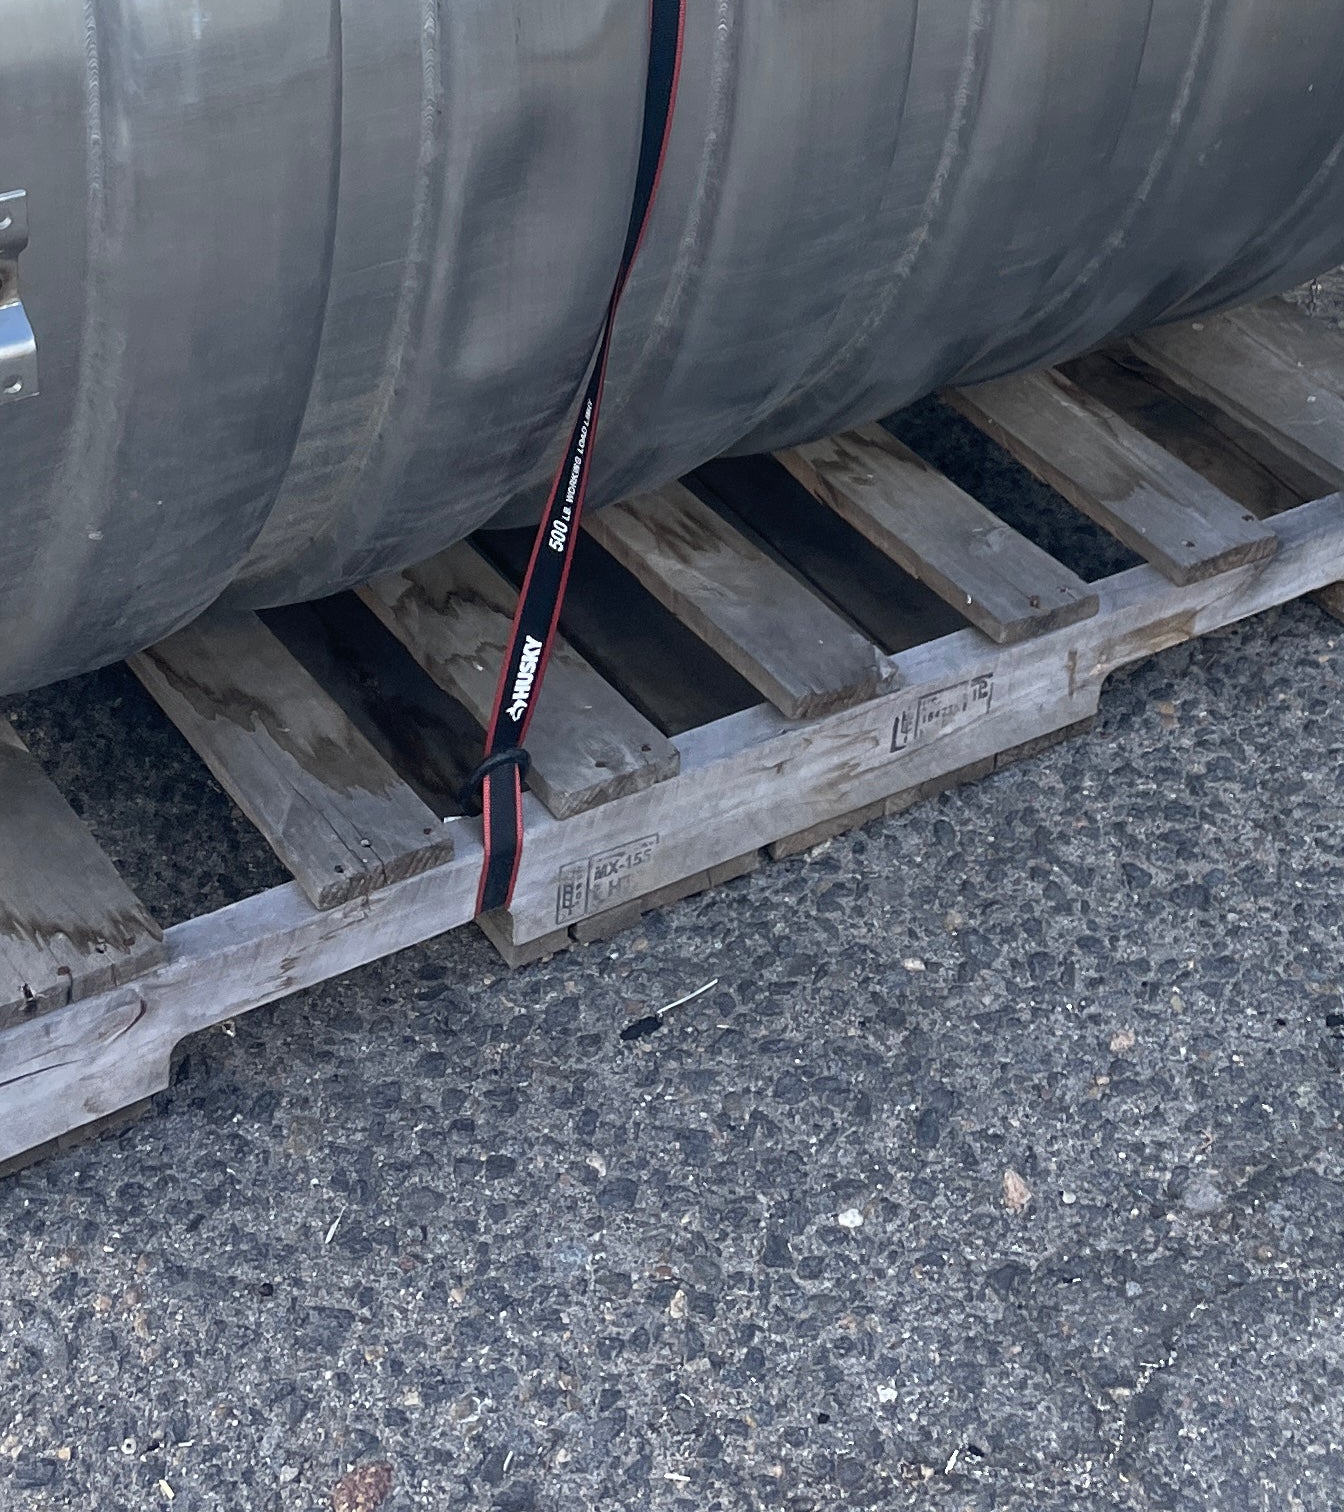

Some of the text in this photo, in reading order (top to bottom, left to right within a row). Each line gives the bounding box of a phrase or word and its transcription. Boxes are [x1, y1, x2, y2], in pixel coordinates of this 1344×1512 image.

[549, 520, 568, 552] 500
[566, 456, 581, 503] WORKING
[577, 425, 587, 454] LOAD
[512, 635, 542, 699] HUSKY
